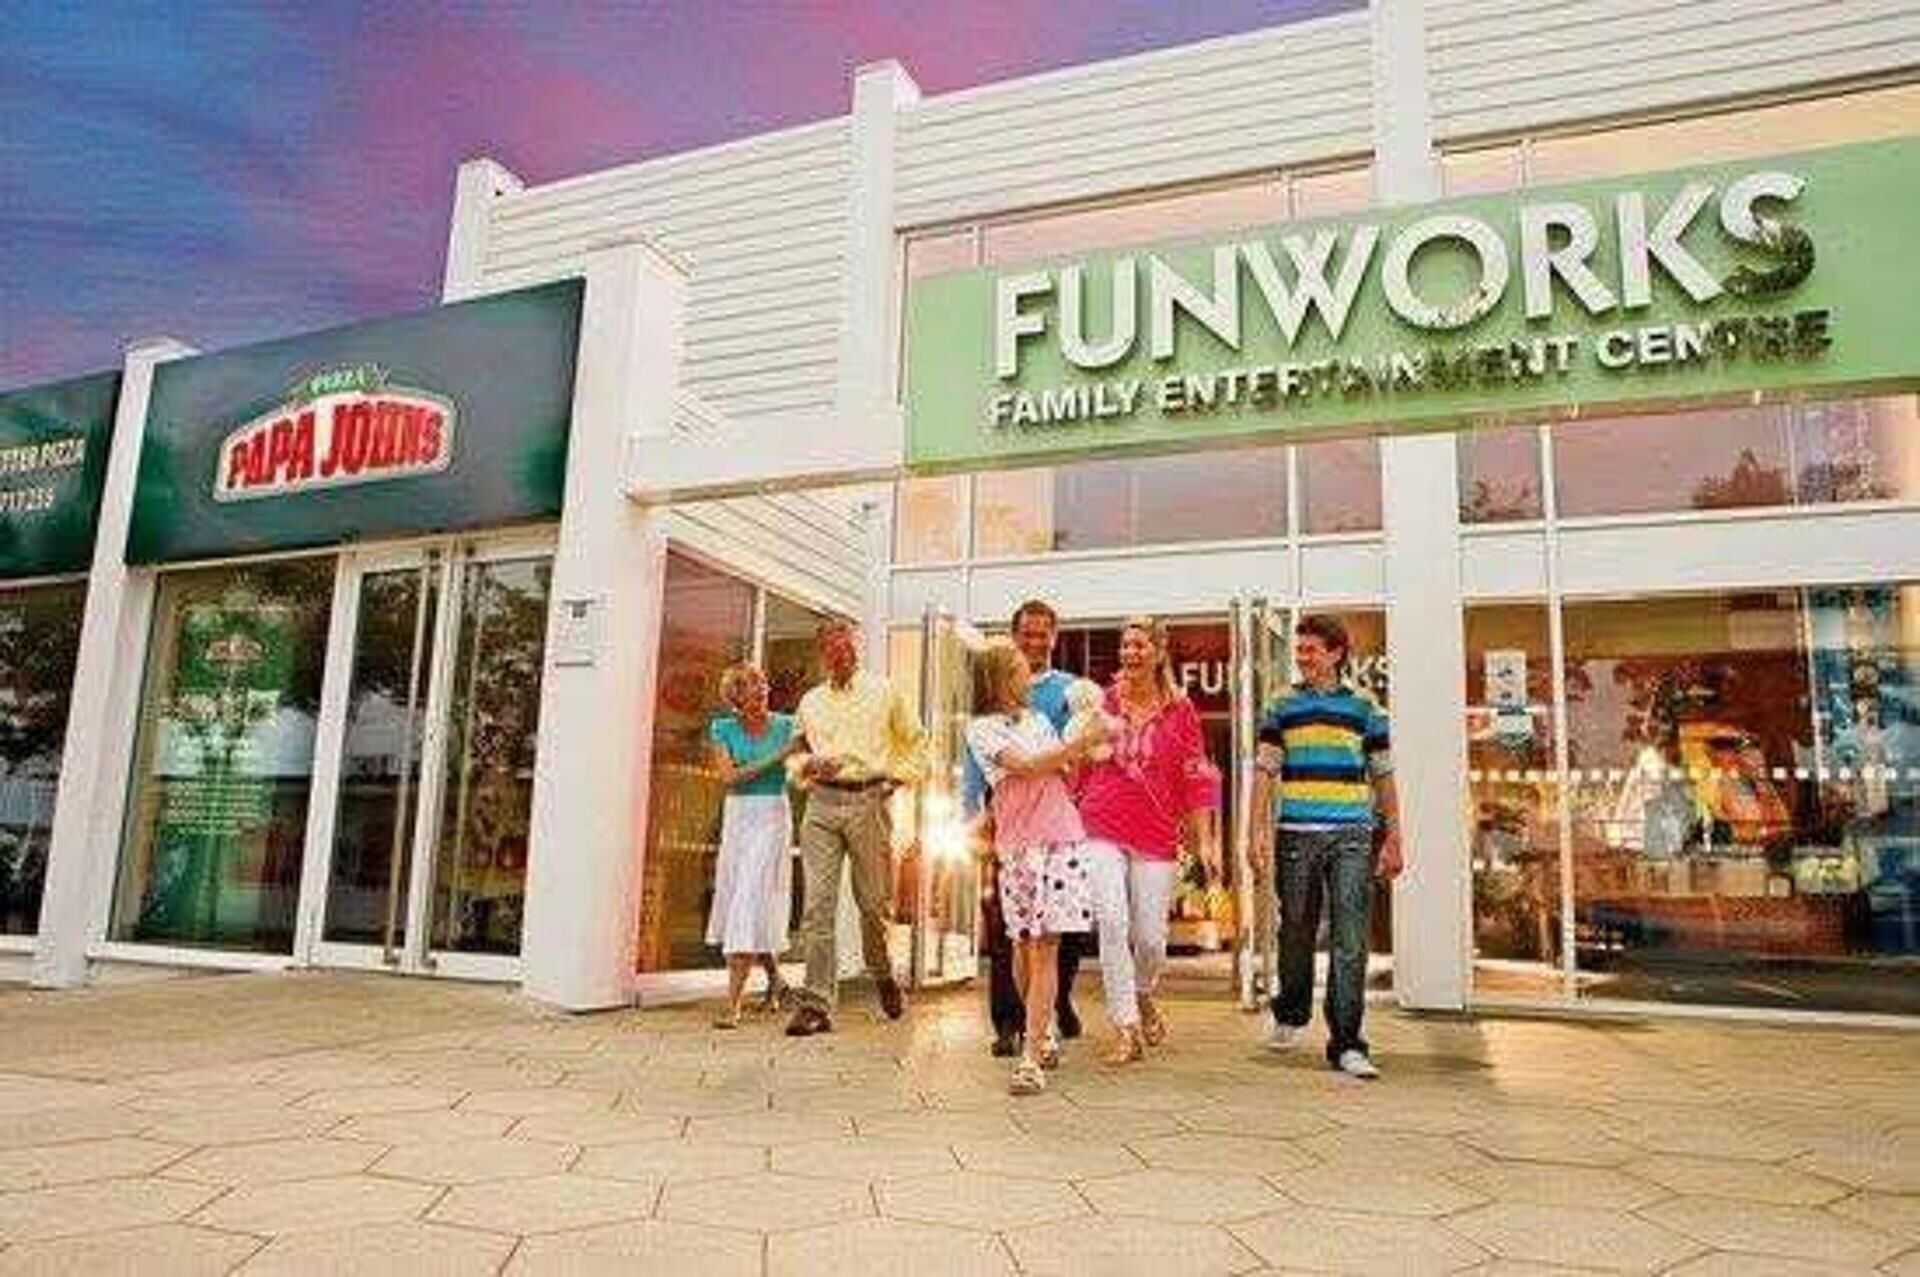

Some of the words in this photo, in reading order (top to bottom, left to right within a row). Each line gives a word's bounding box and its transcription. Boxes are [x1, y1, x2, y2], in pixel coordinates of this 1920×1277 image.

[996, 171, 1815, 381] FUNWORKS
[988, 379, 1140, 427] FAMILY
[1597, 310, 1833, 367] CENTRE
[226, 411, 316, 488] PAPA
[320, 401, 443, 477] JOHNS
